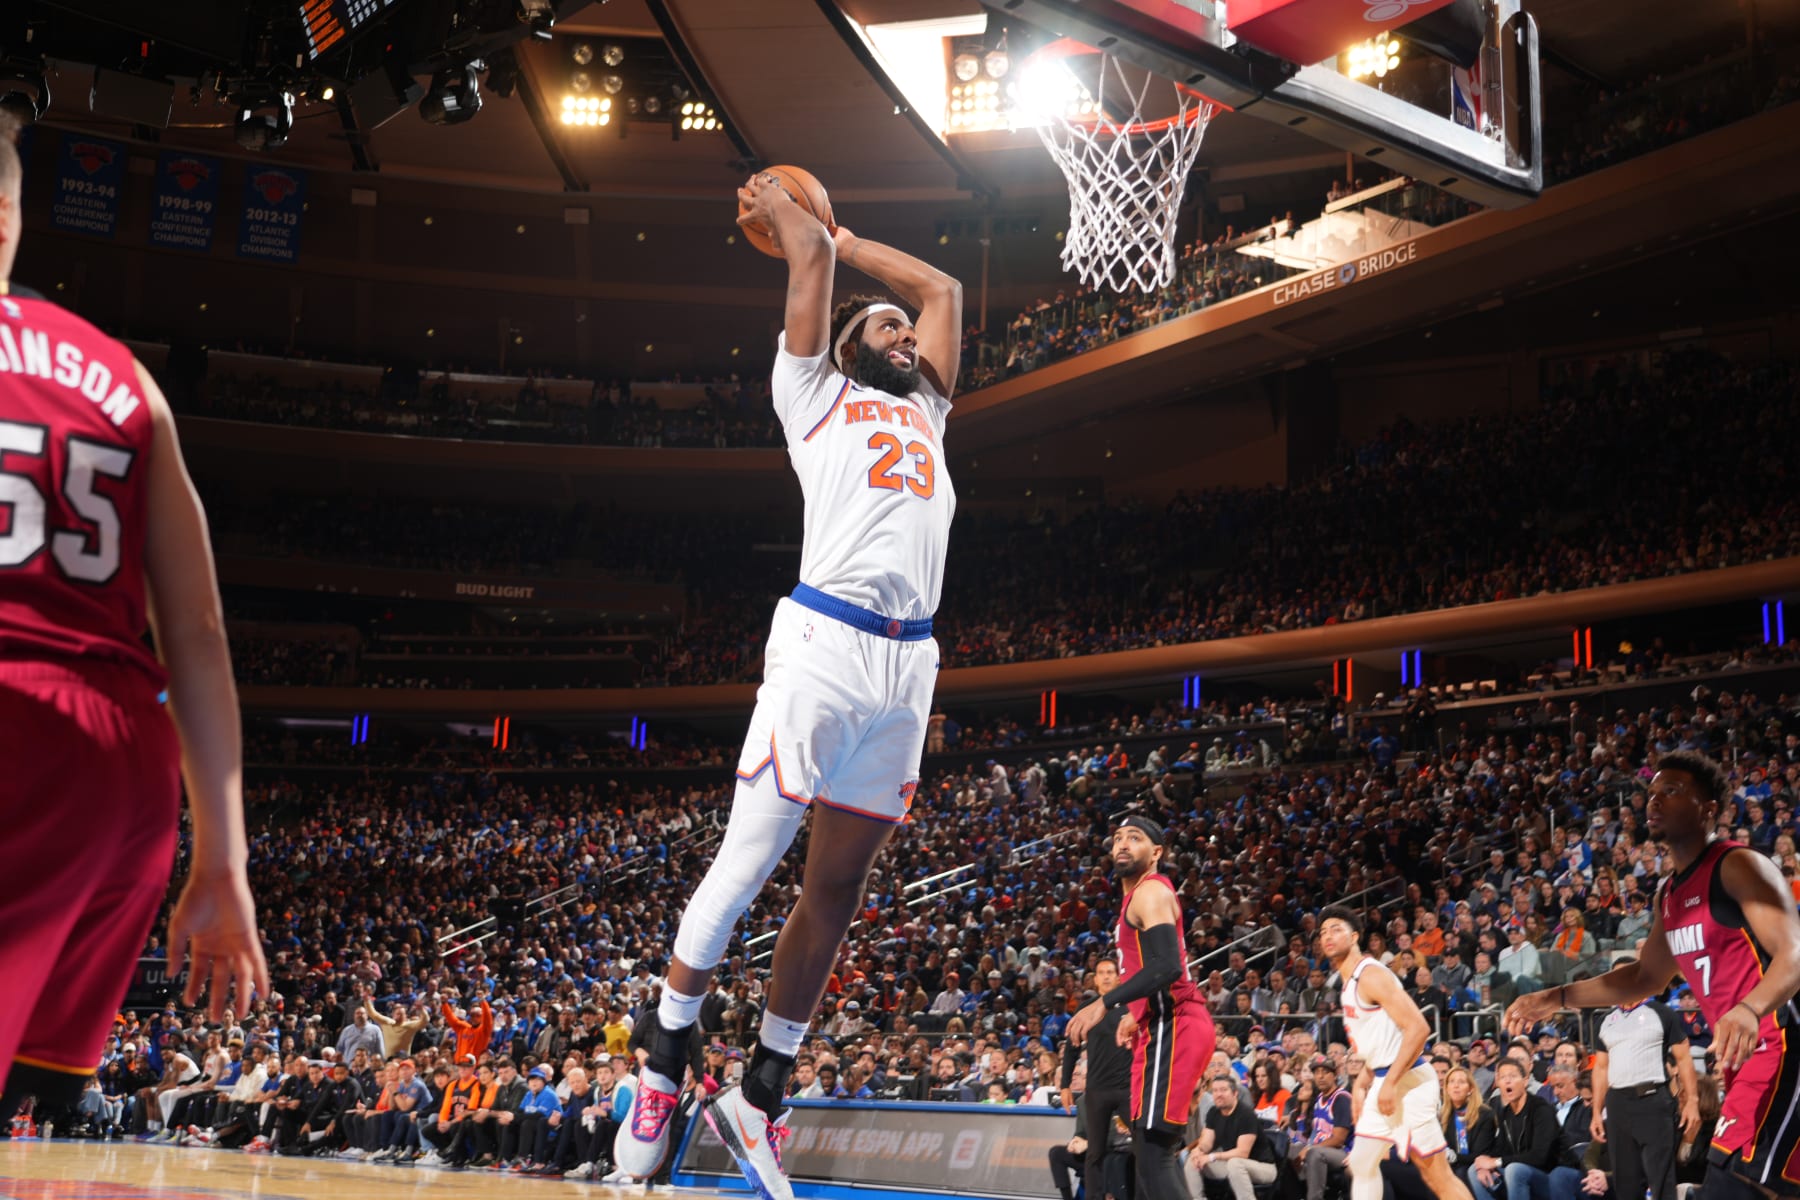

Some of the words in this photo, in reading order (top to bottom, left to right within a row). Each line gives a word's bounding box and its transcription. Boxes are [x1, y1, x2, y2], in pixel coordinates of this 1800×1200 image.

[1456, 106, 1472, 127] NBA
[61, 178, 116, 198] 1993-94
[64, 196, 107, 210] EASTERN
[159, 195, 213, 213] 1998-99
[53, 205, 115, 223] CONFERENCE
[161, 212, 204, 225] EASTERN
[246, 208, 297, 225] 2012-13
[55, 215, 110, 233] CHAMPIONS
[151, 221, 212, 237] CONFERENCE
[248, 224, 291, 237] ATLANTIC
[153, 232, 207, 248] CHAMPIONS
[249, 235, 288, 247] DIVISION
[240, 244, 293, 259] CHAMPIONS
[1273, 271, 1335, 304] CHASE
[1359, 242, 1417, 277] BRIDGE
[844, 400, 893, 425] NEW
[868, 431, 934, 500] 23
[0, 419, 136, 586] 55
[456, 583, 488, 595] BUD
[489, 585, 534, 598] LIGHT
[1694, 955, 1711, 997] 7
[795, 1126, 818, 1150] IN
[819, 1127, 855, 1153] THE
[853, 1129, 905, 1156] ESPN
[901, 1131, 944, 1158] APP.
